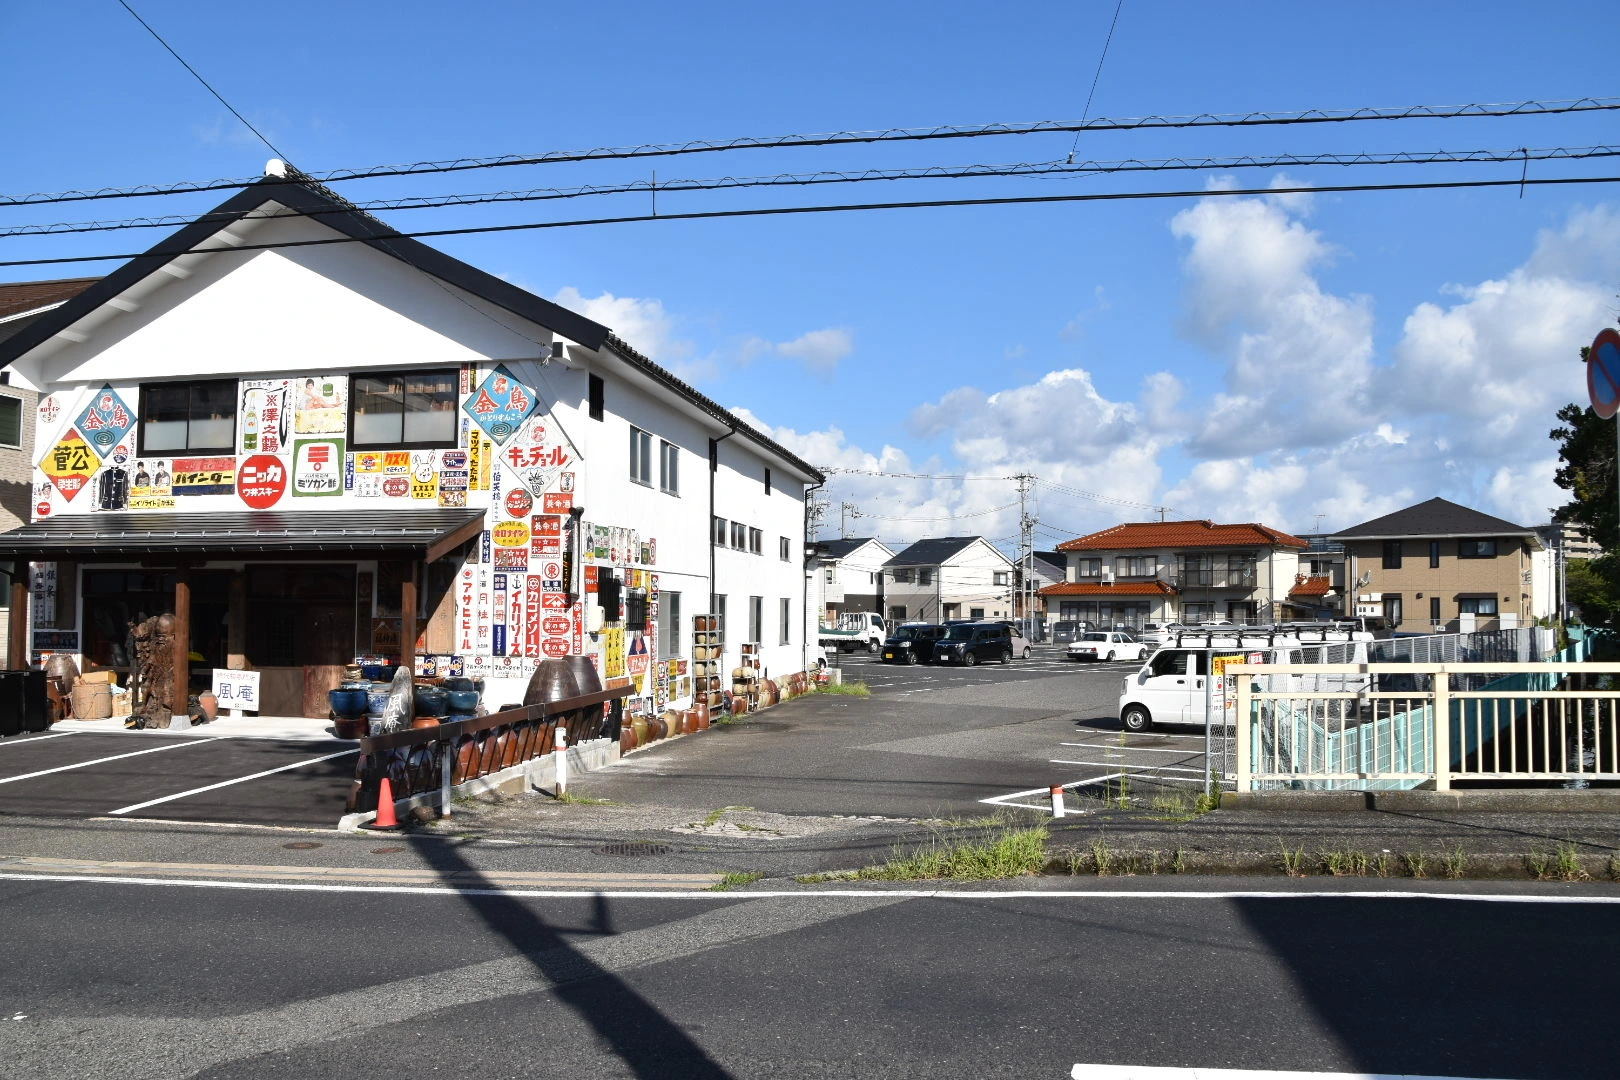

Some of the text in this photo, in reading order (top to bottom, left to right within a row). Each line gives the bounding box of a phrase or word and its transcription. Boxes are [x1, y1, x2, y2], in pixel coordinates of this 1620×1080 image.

[470, 385, 531, 414] 金鳥
[81, 404, 130, 431] 金鳥
[480, 413, 523, 422] かとりせんこう
[54, 445, 90, 471] 菅公
[385, 453, 410, 465] クスリ
[508, 445, 568, 467] キンチョール
[243, 465, 281, 485] ニッカ
[298, 479, 337, 488] ミツカン酢
[461, 582, 473, 650] アサヒビール
[511, 590, 522, 655] イカリソース
[527, 590, 539, 656] カゴメソース
